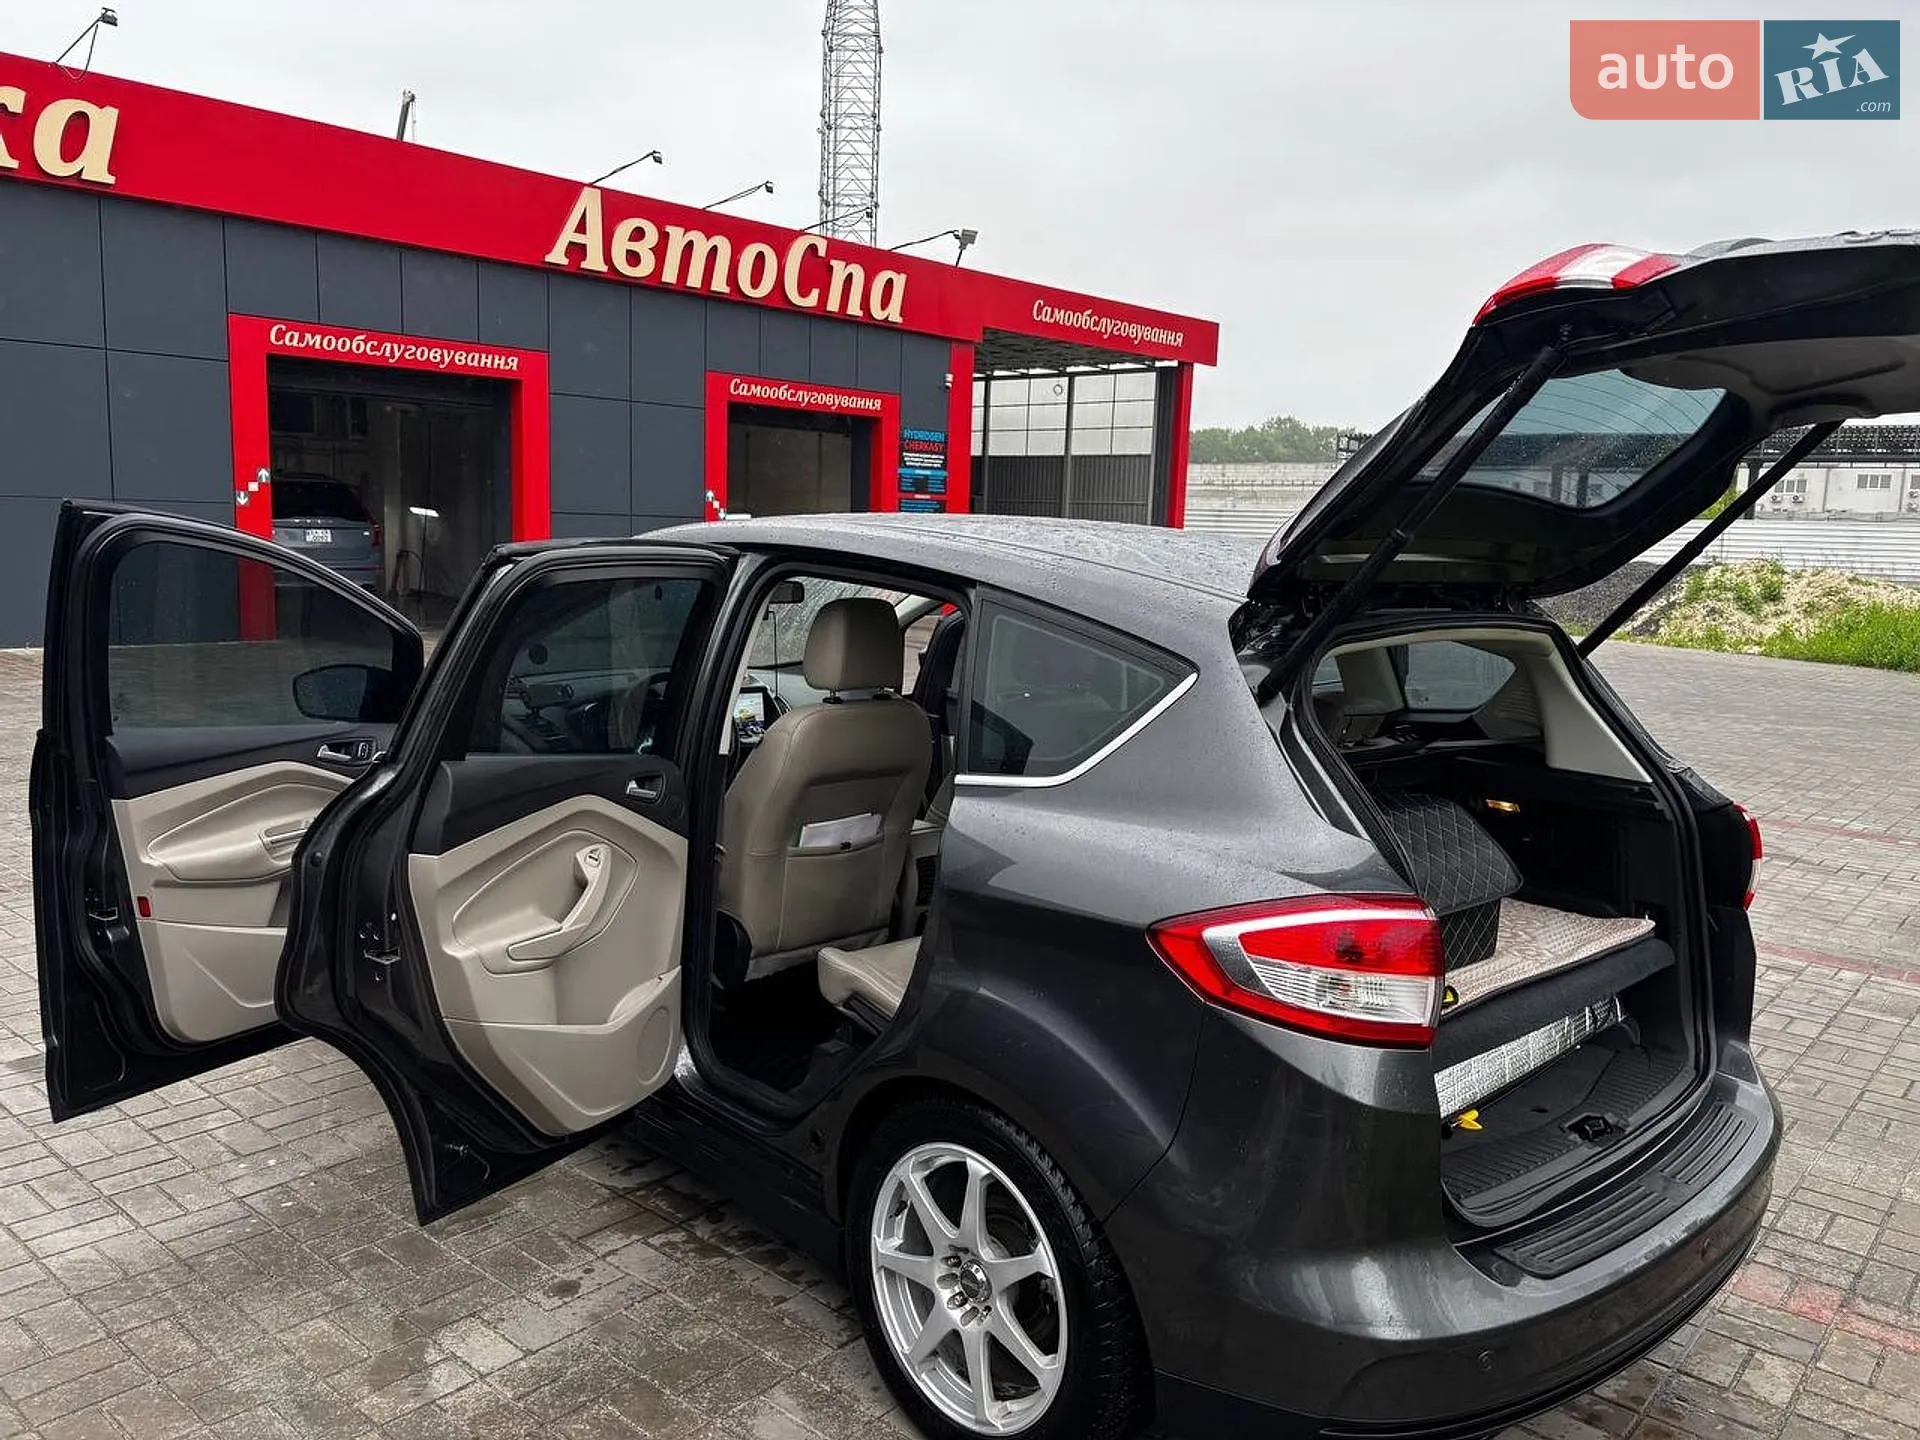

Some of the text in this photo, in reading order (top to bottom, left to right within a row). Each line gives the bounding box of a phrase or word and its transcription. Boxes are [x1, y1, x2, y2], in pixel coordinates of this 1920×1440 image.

[545, 186, 907, 323] АвтоСпа
[269, 323, 519, 371] Самообслуговування
[1032, 299, 1184, 347] Самообслуговування
[730, 377, 882, 410] Самообслуговування
